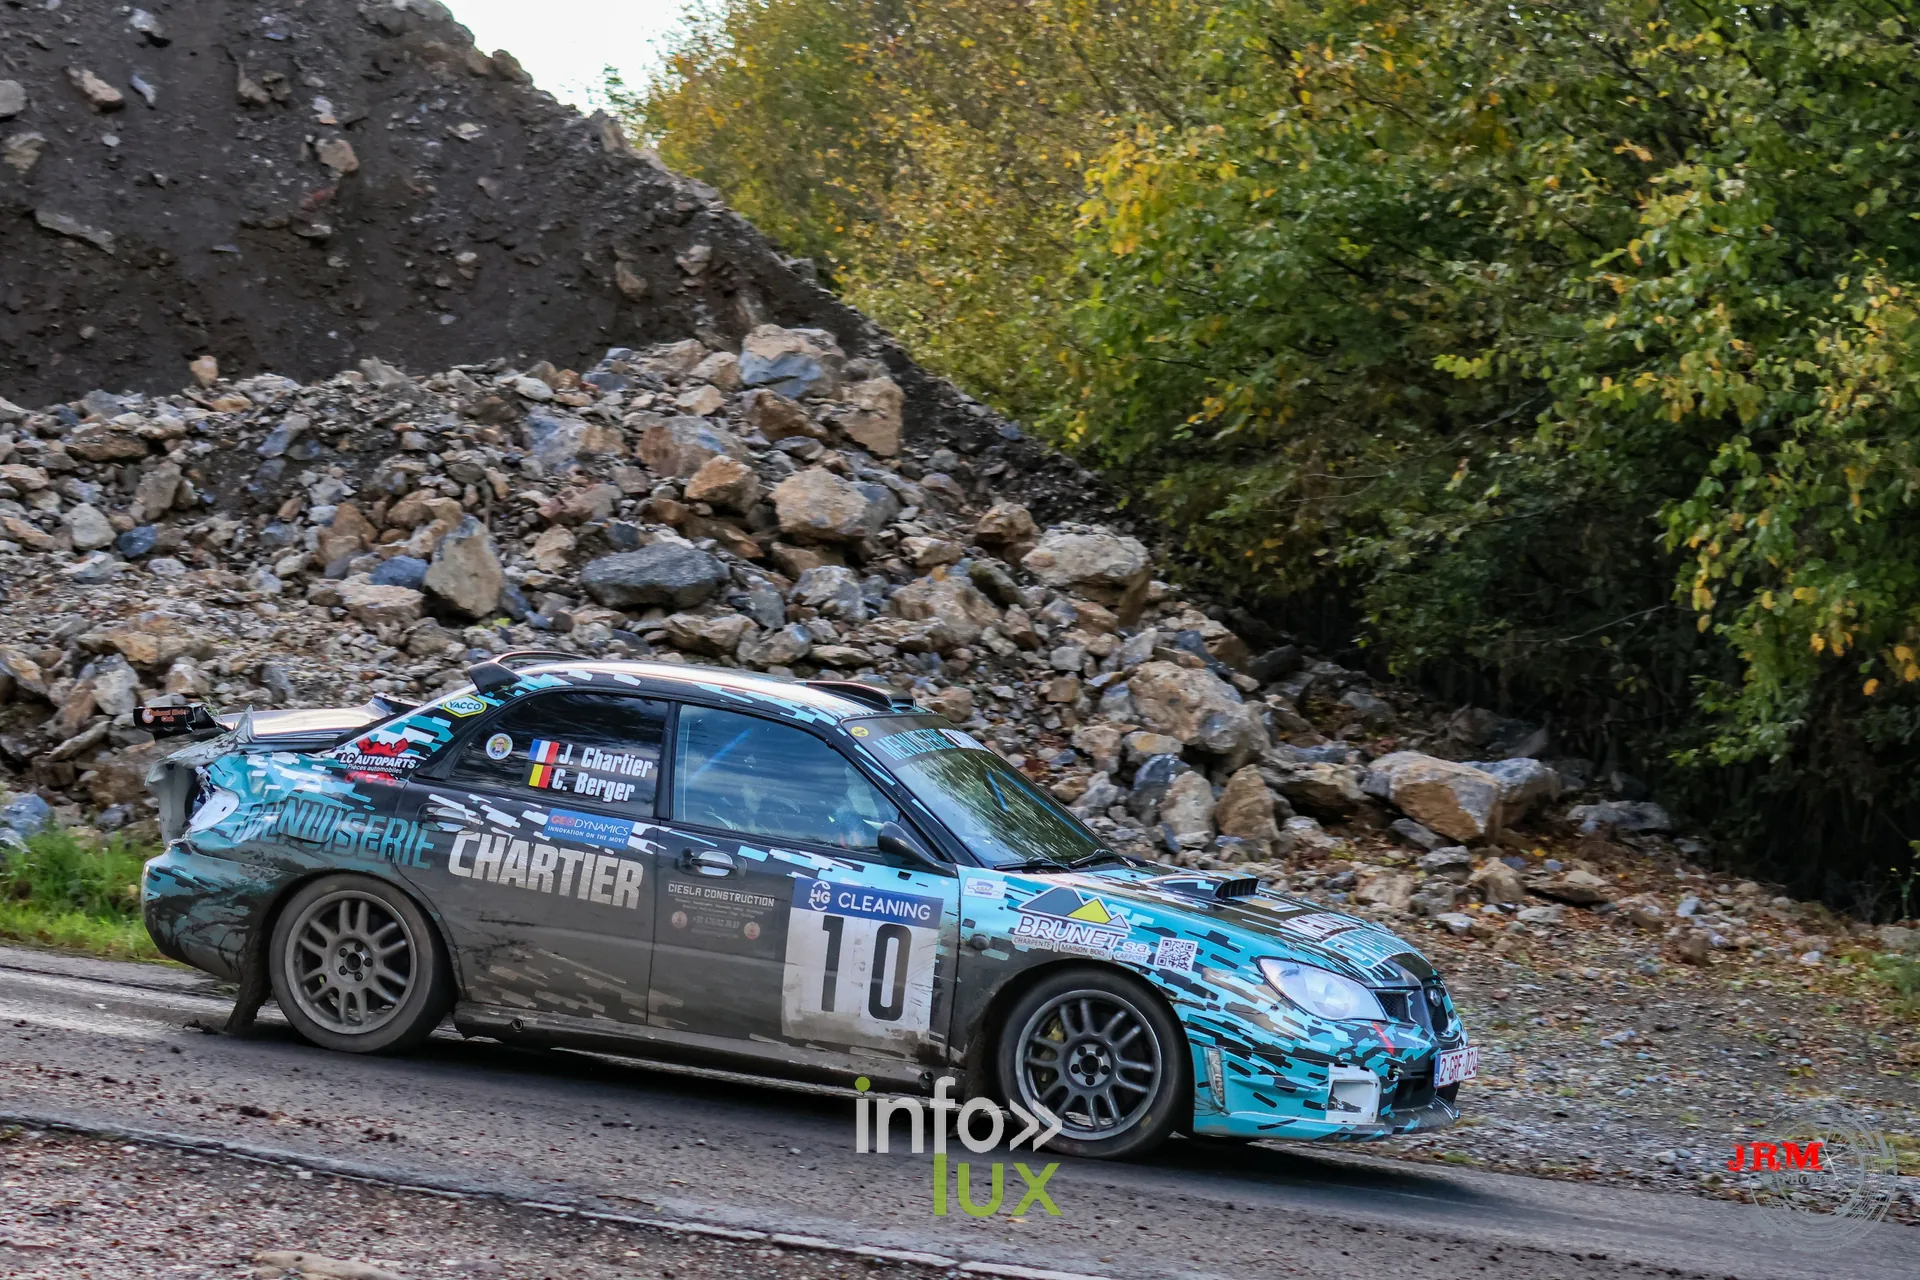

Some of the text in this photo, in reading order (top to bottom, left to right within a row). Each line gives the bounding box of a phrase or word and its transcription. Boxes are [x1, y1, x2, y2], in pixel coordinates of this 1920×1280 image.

[450, 700, 481, 711] YACCO
[340, 753, 417, 769] LC AUTOPARTS
[559, 743, 653, 778] J. Chartier
[552, 768, 635, 802] C. Berger
[548, 825, 584, 837] INNOVATION
[586, 831, 596, 839] ON
[551, 815, 630, 836] GEODYNAMICS
[448, 831, 645, 910] CHARTIER
[668, 883, 702, 897] CIESLA
[704, 889, 775, 907] CONSTRUCTION
[838, 892, 931, 920] CLEANING
[1017, 915, 1126, 948] BRUNET
[1062, 944, 1088, 953] MAISON
[1090, 948, 1106, 957] BOIS
[821, 915, 912, 1021] 10
